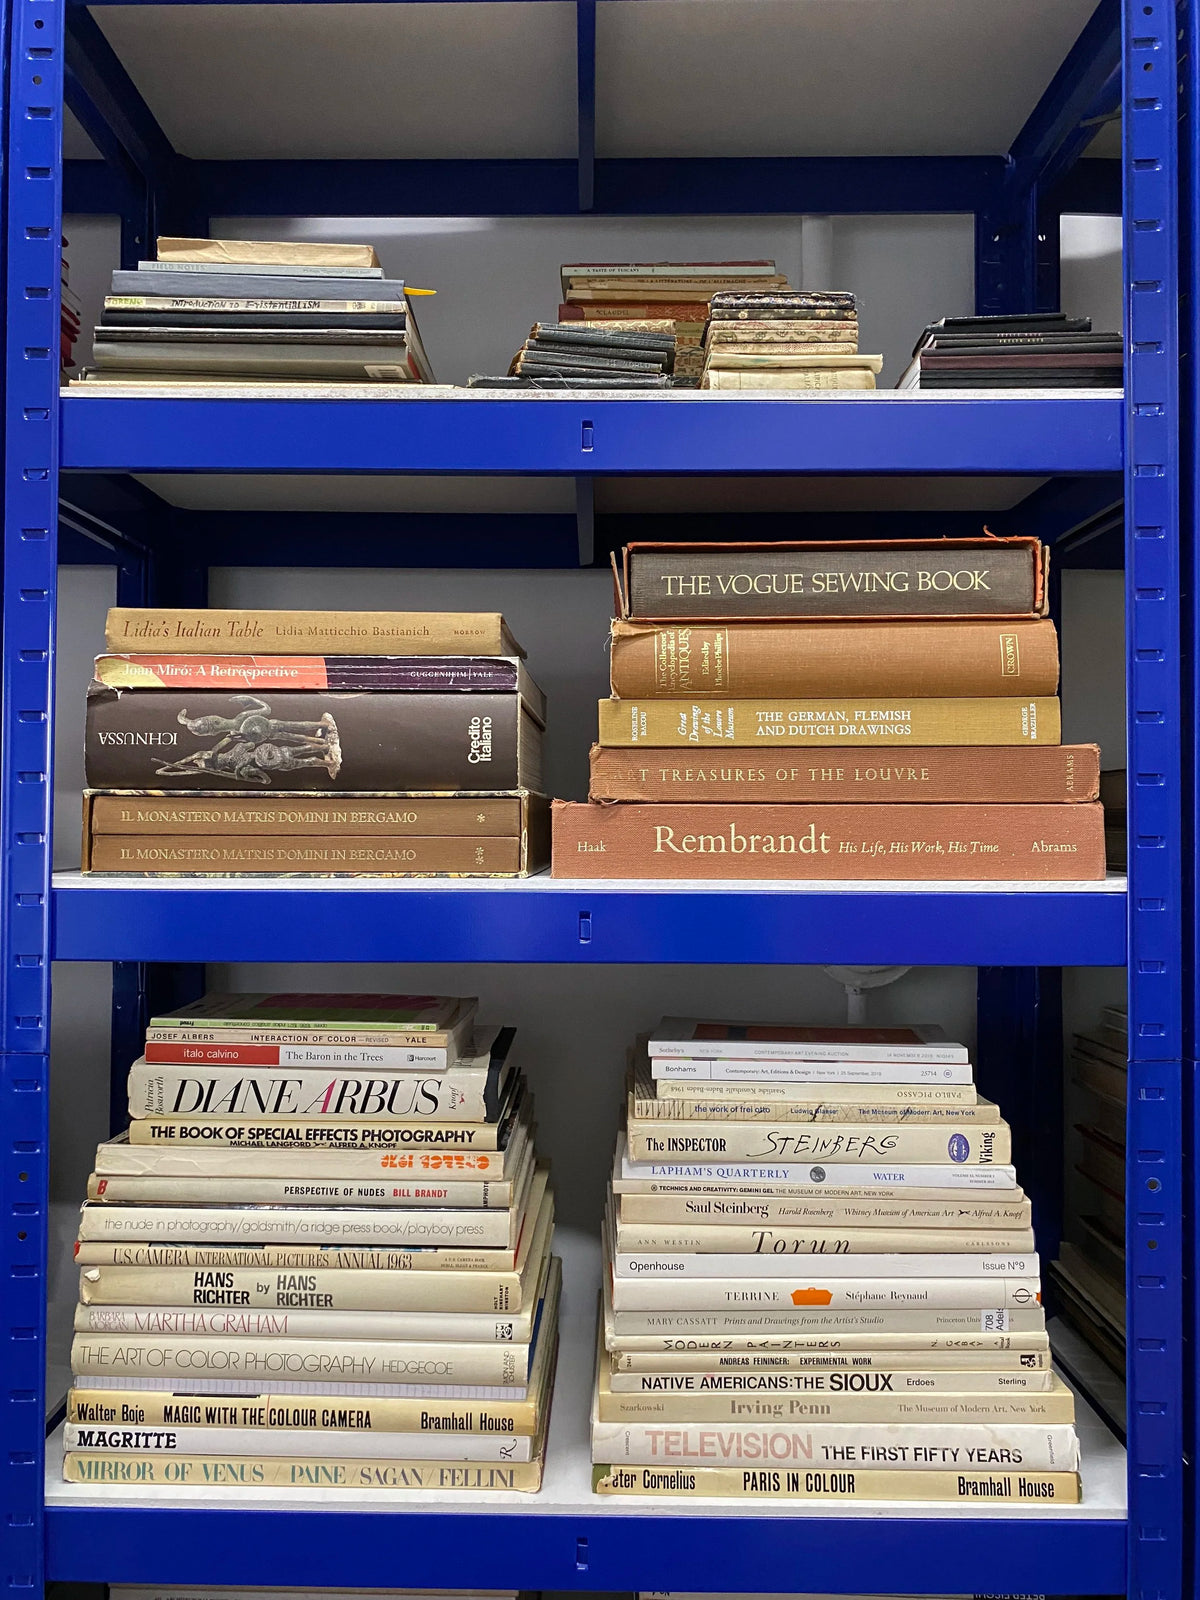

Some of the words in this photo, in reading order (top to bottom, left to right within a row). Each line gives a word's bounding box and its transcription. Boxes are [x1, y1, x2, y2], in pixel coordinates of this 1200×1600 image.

[661, 576, 710, 596] THE
[716, 573, 804, 594] VOGUE
[812, 572, 908, 593] SEWING
[917, 570, 991, 591] BOOK
[122, 620, 169, 638] Lidia's
[174, 620, 221, 638] Italian
[227, 620, 264, 638] Table
[276, 626, 303, 636] Lidia
[308, 626, 368, 636] Matticchio
[373, 626, 430, 636] Bastianich
[678, 628, 692, 690] ANTIQUES
[1006, 637, 1015, 674] CROWN
[122, 664, 153, 676] Joan
[157, 663, 192, 676] Miró:
[196, 664, 206, 676] A
[210, 665, 298, 680] Retrospective
[756, 712, 783, 722] THE
[788, 712, 849, 722] GERMAN,
[854, 710, 911, 721] FLEMISH
[98, 732, 178, 745] ICHNUSSA
[480, 716, 492, 761] Italiano
[756, 726, 785, 736] AND
[788, 726, 834, 736] DUTCH
[839, 724, 911, 735] DRAWINGS
[468, 716, 480, 764] Credito
[659, 769, 766, 782] TREASURES
[776, 769, 798, 781] OF
[808, 768, 844, 780] THE
[855, 768, 930, 780] LOUVRE
[120, 810, 134, 822] IL
[137, 811, 221, 822] MONASTERO
[223, 811, 275, 822] MATRIS
[278, 812, 328, 822] DOMINI
[332, 812, 346, 822] IN
[350, 812, 417, 822] BERGAMO
[578, 841, 606, 852] Haak
[653, 823, 830, 854] Rembrandt
[839, 842, 858, 853] His
[861, 842, 886, 856] Life,
[889, 842, 908, 853] His
[911, 842, 944, 854] Work,
[948, 842, 967, 853] His
[970, 842, 999, 854] Time
[1031, 840, 1077, 852] Abrams
[184, 1049, 204, 1058] italo
[206, 1050, 239, 1058] calvino
[286, 1052, 303, 1060] The
[306, 1052, 330, 1060] Baron
[334, 1052, 342, 1060] in
[344, 1052, 358, 1060] the
[360, 1052, 384, 1061] Trees
[169, 1078, 302, 1114] DIANE
[301, 1078, 442, 1114] ARBUS
[150, 1126, 176, 1138] THE
[180, 1126, 224, 1139] BOOK
[225, 1127, 245, 1140] OF
[248, 1128, 302, 1140] SPECIAL
[306, 1128, 358, 1141] EFFECTS
[362, 1130, 476, 1143] PHOTOGRAPHY
[646, 1138, 664, 1151] The
[668, 1138, 726, 1152] INSPECTOR
[746, 1131, 900, 1160] STEINBERG
[980, 1132, 995, 1164] Viking
[652, 1166, 712, 1176] LAPHAM'S
[716, 1168, 789, 1178] QUARTERLY
[873, 1172, 904, 1181] WATER
[284, 1186, 338, 1196] PERSPECTIVE
[343, 1188, 354, 1196] OF
[358, 1188, 386, 1196] NUDES
[393, 1188, 411, 1197] BILL
[415, 1189, 448, 1198] BRANDT
[686, 1201, 710, 1213] Saul
[714, 1201, 769, 1218] Steinberg
[630, 1261, 684, 1272] Openhouse
[982, 1261, 1006, 1270] Issue
[194, 1272, 234, 1288] HANS
[256, 1282, 270, 1294] by
[277, 1275, 316, 1291] HANS
[194, 1290, 250, 1304] RICHTER
[277, 1292, 333, 1307] RICHTER
[724, 1292, 780, 1300] TERRINE
[846, 1291, 886, 1302] Stéphane
[890, 1291, 928, 1302] Reynaud
[134, 1312, 207, 1332] MARTHA
[210, 1314, 288, 1334] GRAHAM
[80, 1346, 110, 1364] THE
[112, 1347, 146, 1366] ART
[146, 1348, 174, 1366] OF
[176, 1350, 240, 1370] COLOR
[245, 1352, 376, 1373] PHOTOGRAPHY
[382, 1359, 453, 1375] HEDGECOE
[800, 1358, 848, 1366] EXPERIMENTAL
[852, 1358, 872, 1366] WORK
[642, 1377, 694, 1389] NATIVE
[830, 1374, 894, 1391] SIOUX
[906, 1378, 934, 1386] Erdoes
[998, 1378, 1026, 1388] Sterling
[78, 1404, 116, 1422] Walter
[122, 1404, 144, 1424] Boje
[164, 1406, 200, 1423] MAGIC
[206, 1407, 238, 1424] WITH
[242, 1408, 265, 1425] THE
[270, 1408, 316, 1426] COLOUR
[322, 1409, 372, 1428] CAMERA
[421, 1412, 472, 1430] Bramhall
[480, 1413, 514, 1431] House
[730, 1400, 784, 1418] Irving
[790, 1400, 830, 1414] Penn
[78, 1431, 176, 1448] MAGRITTE
[645, 1430, 812, 1459] TELEVISION
[822, 1446, 856, 1460] THE
[861, 1446, 908, 1462] FIRST
[914, 1448, 959, 1462] FIFTY
[965, 1448, 1022, 1463] YEARS
[78, 1460, 153, 1480] MIRROR
[164, 1462, 192, 1481] OF
[202, 1464, 264, 1482] VENUS
[291, 1465, 346, 1484] PAINE
[360, 1468, 422, 1485] SAGAN
[439, 1468, 520, 1488] FELLINI
[642, 1470, 696, 1490] Cornelius
[743, 1472, 780, 1491] PARIS
[787, 1473, 799, 1492] IN
[806, 1472, 855, 1492] COLOUR
[958, 1476, 1011, 1496] Bramhall
[1019, 1478, 1054, 1498] House
